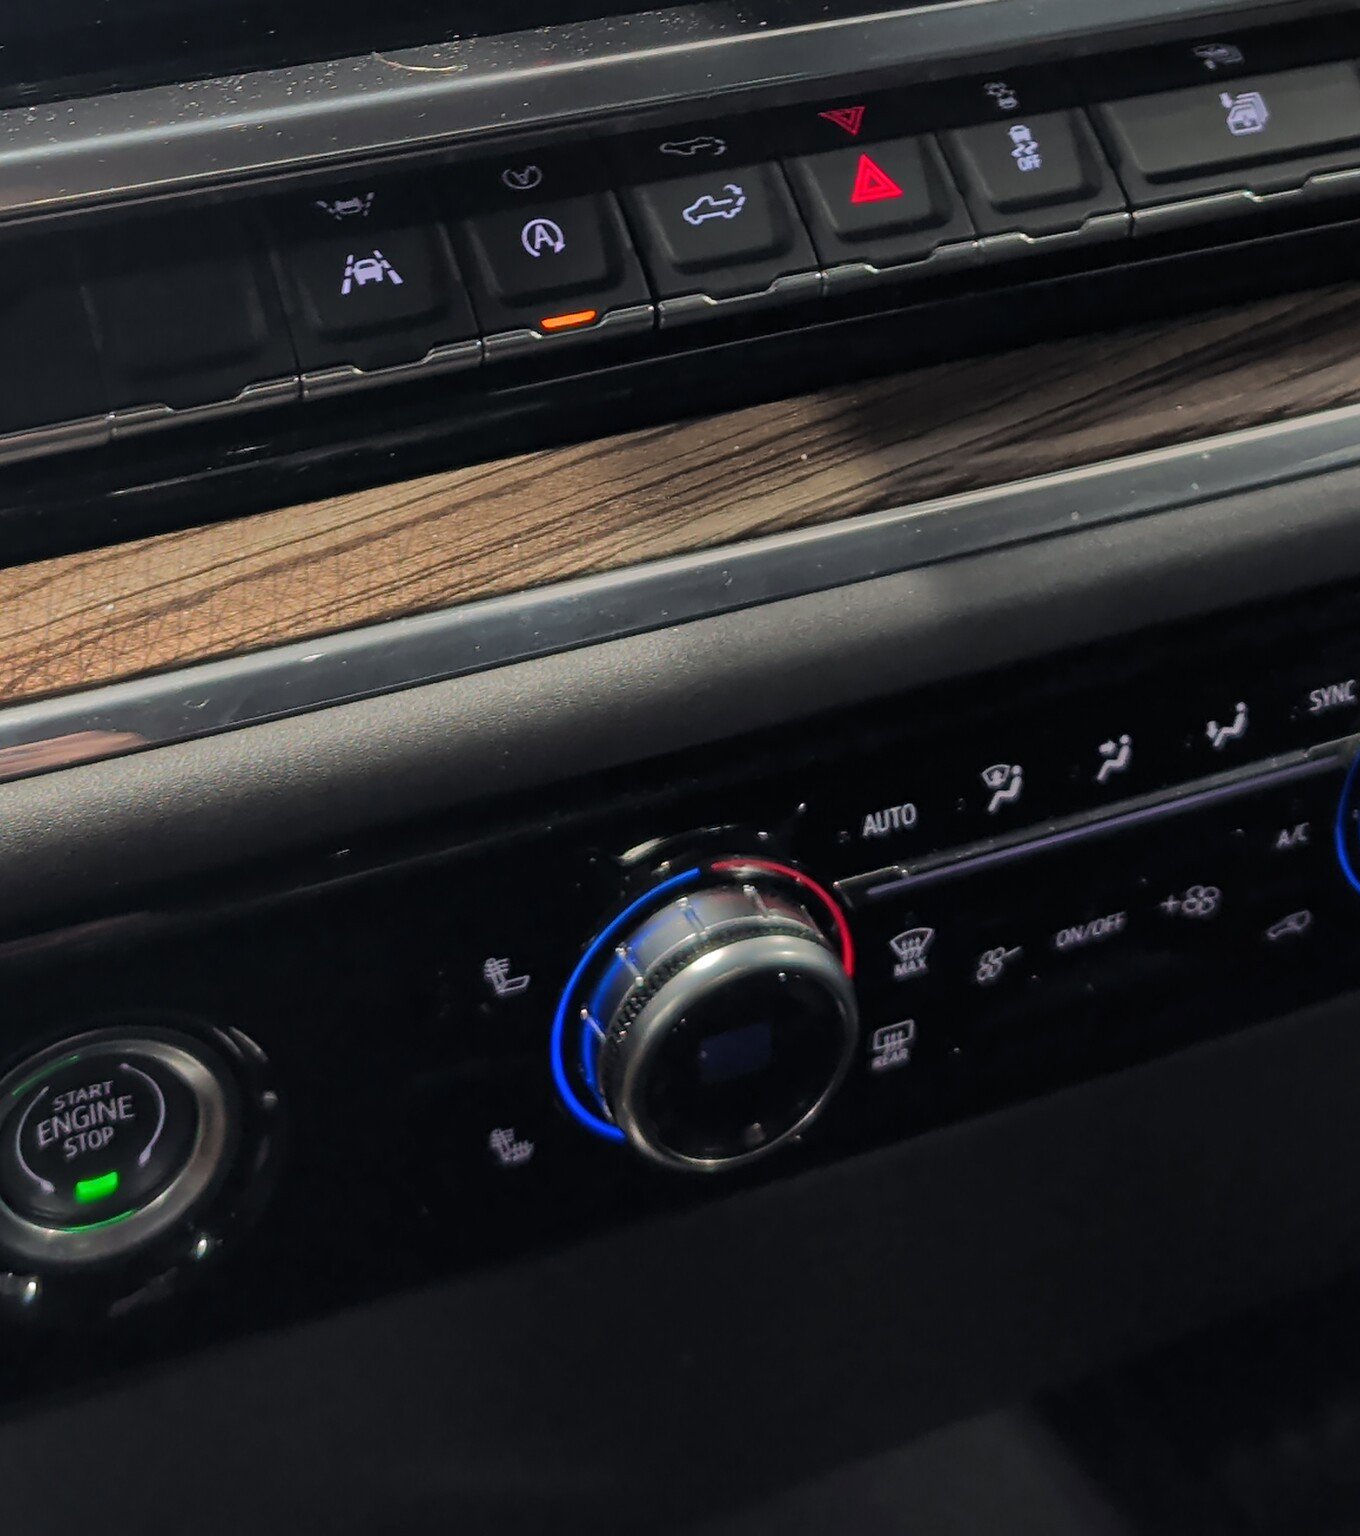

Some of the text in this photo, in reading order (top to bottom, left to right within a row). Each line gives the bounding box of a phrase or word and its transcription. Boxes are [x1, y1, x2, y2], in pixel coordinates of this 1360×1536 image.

[1310, 680, 1357, 711] SYNC
[863, 803, 917, 837] AUTO
[1276, 823, 1309, 848] A/C
[1057, 913, 1125, 949] ON/OFF
[54, 1081, 114, 1110] START
[37, 1094, 137, 1146] ENGINE
[64, 1127, 115, 1158] STOP
